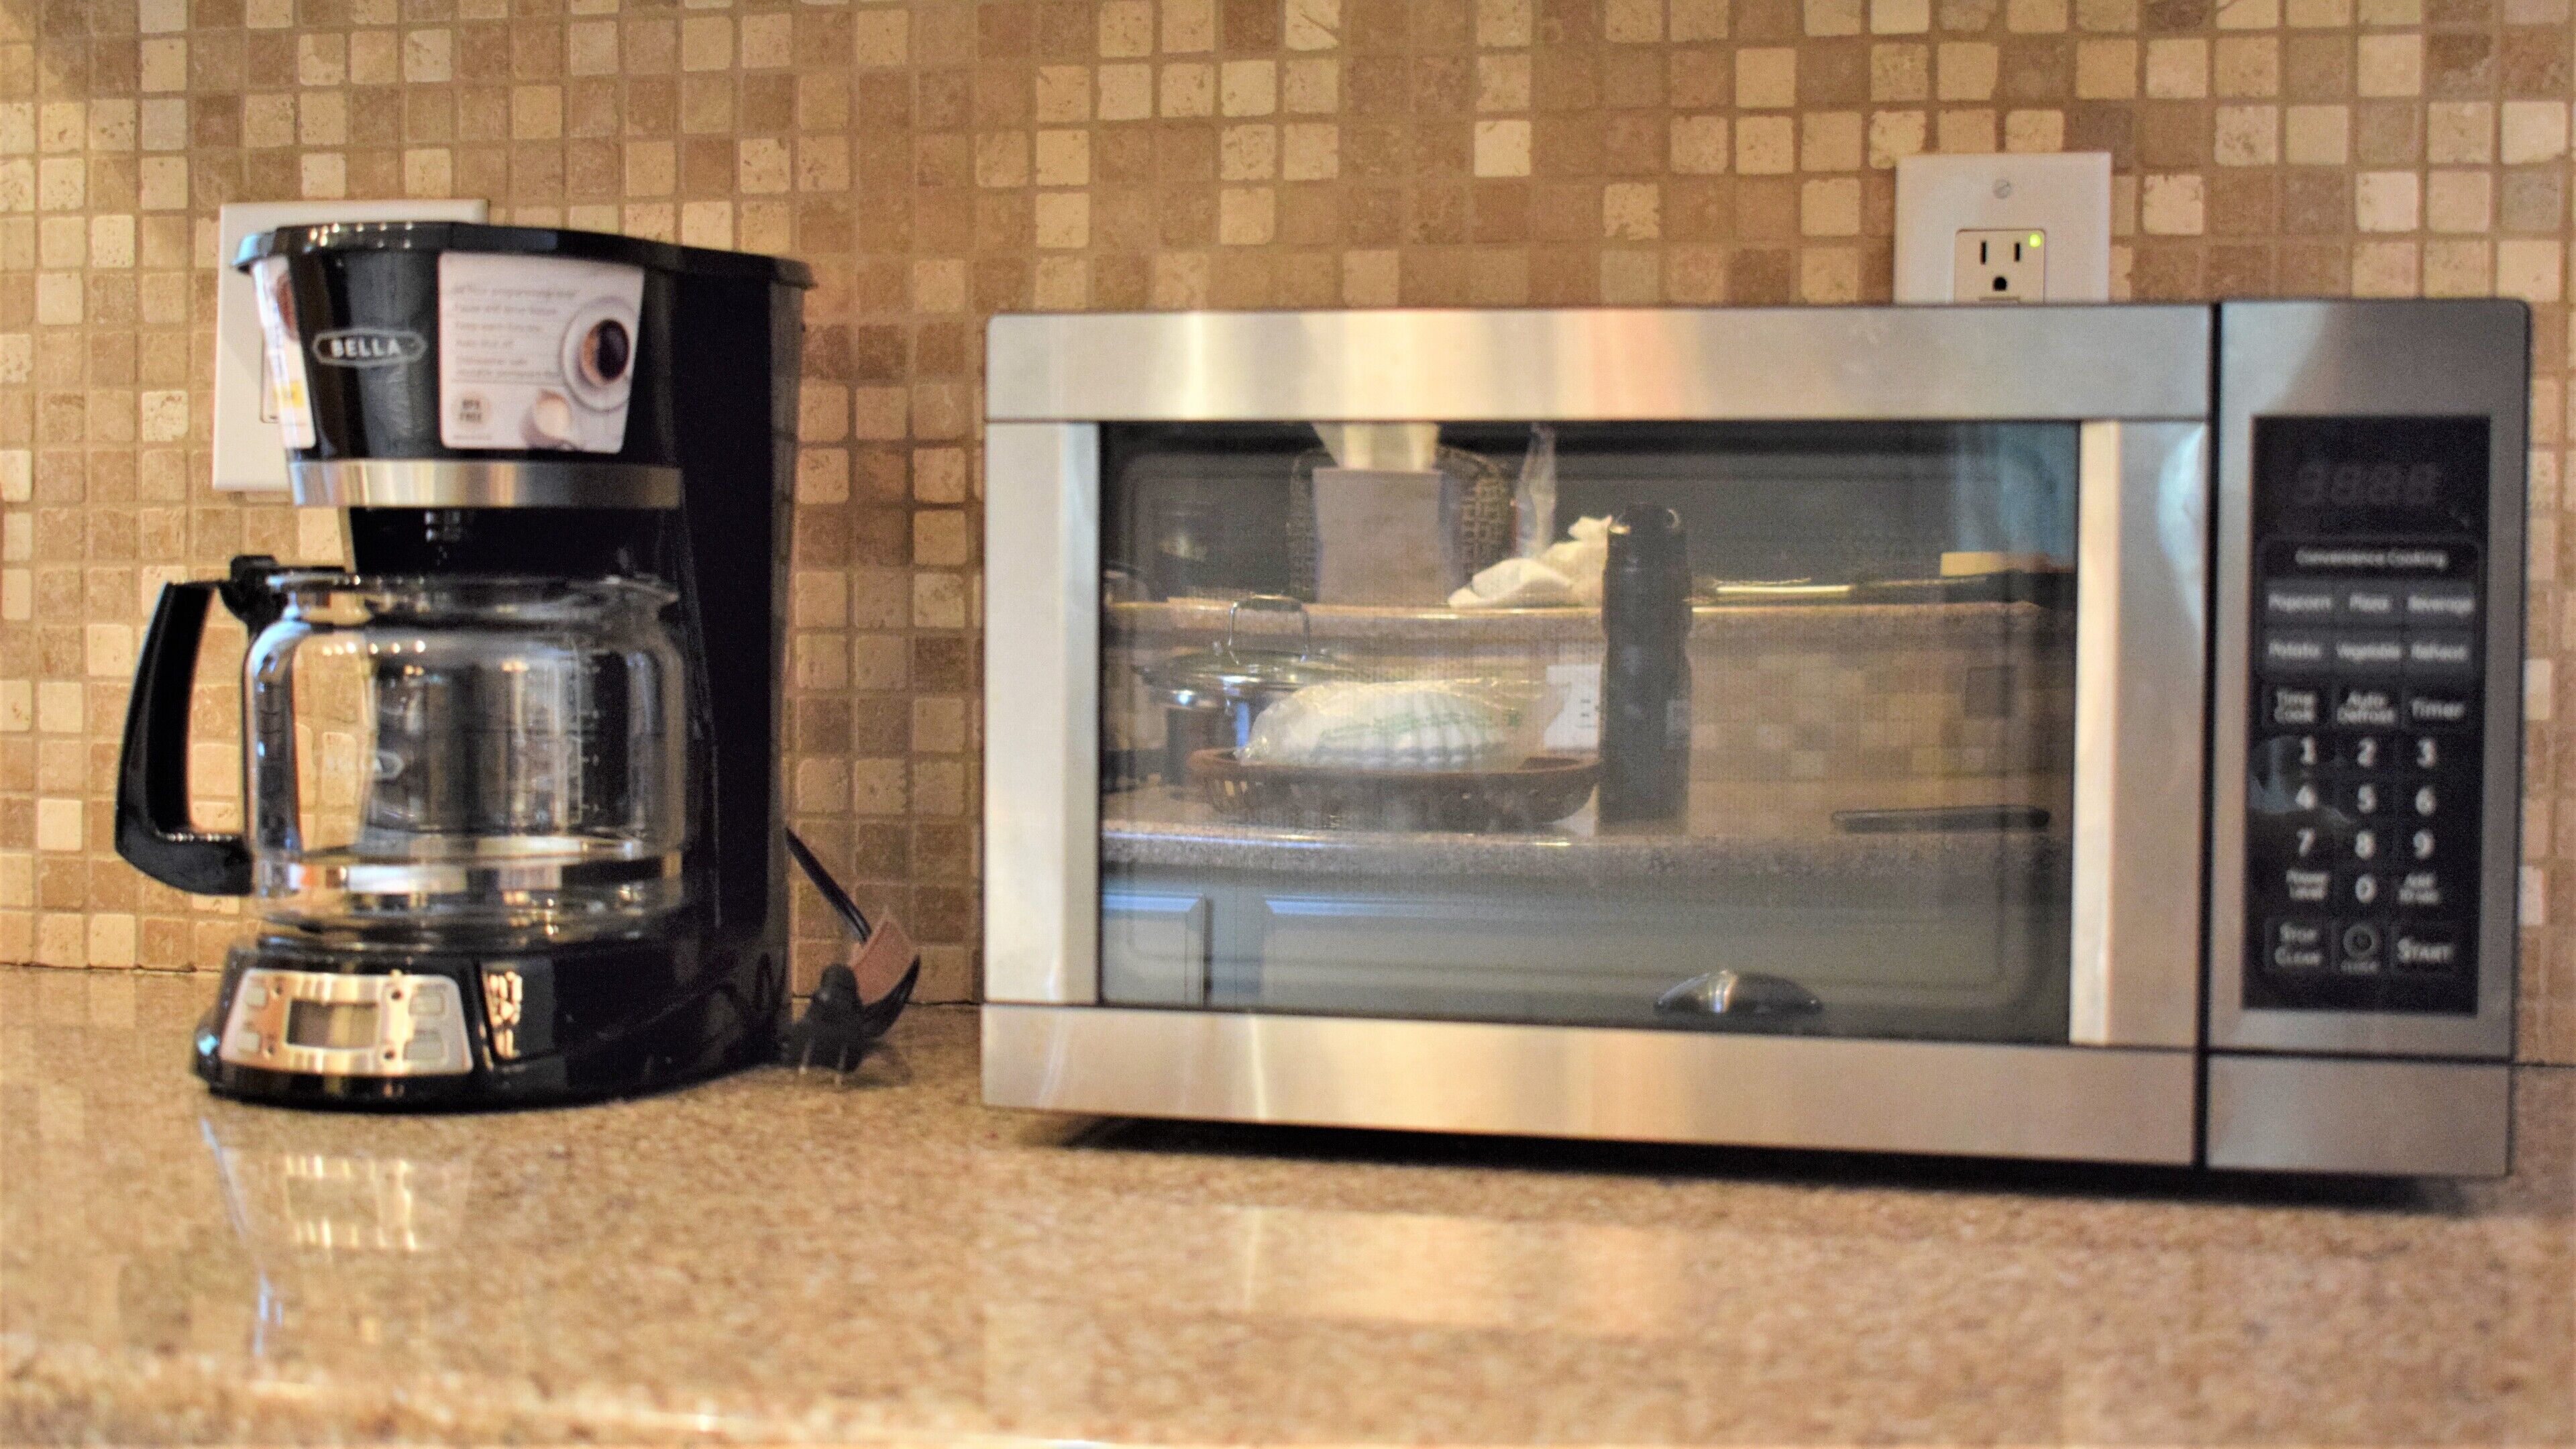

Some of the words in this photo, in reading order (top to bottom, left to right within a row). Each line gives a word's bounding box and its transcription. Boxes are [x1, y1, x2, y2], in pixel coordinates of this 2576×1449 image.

[331, 338, 402, 358] BELLA
[2296, 549, 2386, 566] Convenience
[2387, 551, 2447, 568] Cooking
[2348, 692, 2387, 708] Auto
[2410, 698, 2464, 718] Timer
[2301, 737, 2315, 764] 1
[2357, 739, 2375, 767] 2
[2418, 739, 2436, 767] 3
[2295, 786, 2316, 809] 4
[2358, 785, 2375, 812] 5
[2416, 788, 2435, 814] 6
[2298, 828, 2315, 855] 7
[2355, 832, 2374, 858] 8
[2414, 831, 2433, 858] 9
[2355, 875, 2376, 902] 0
